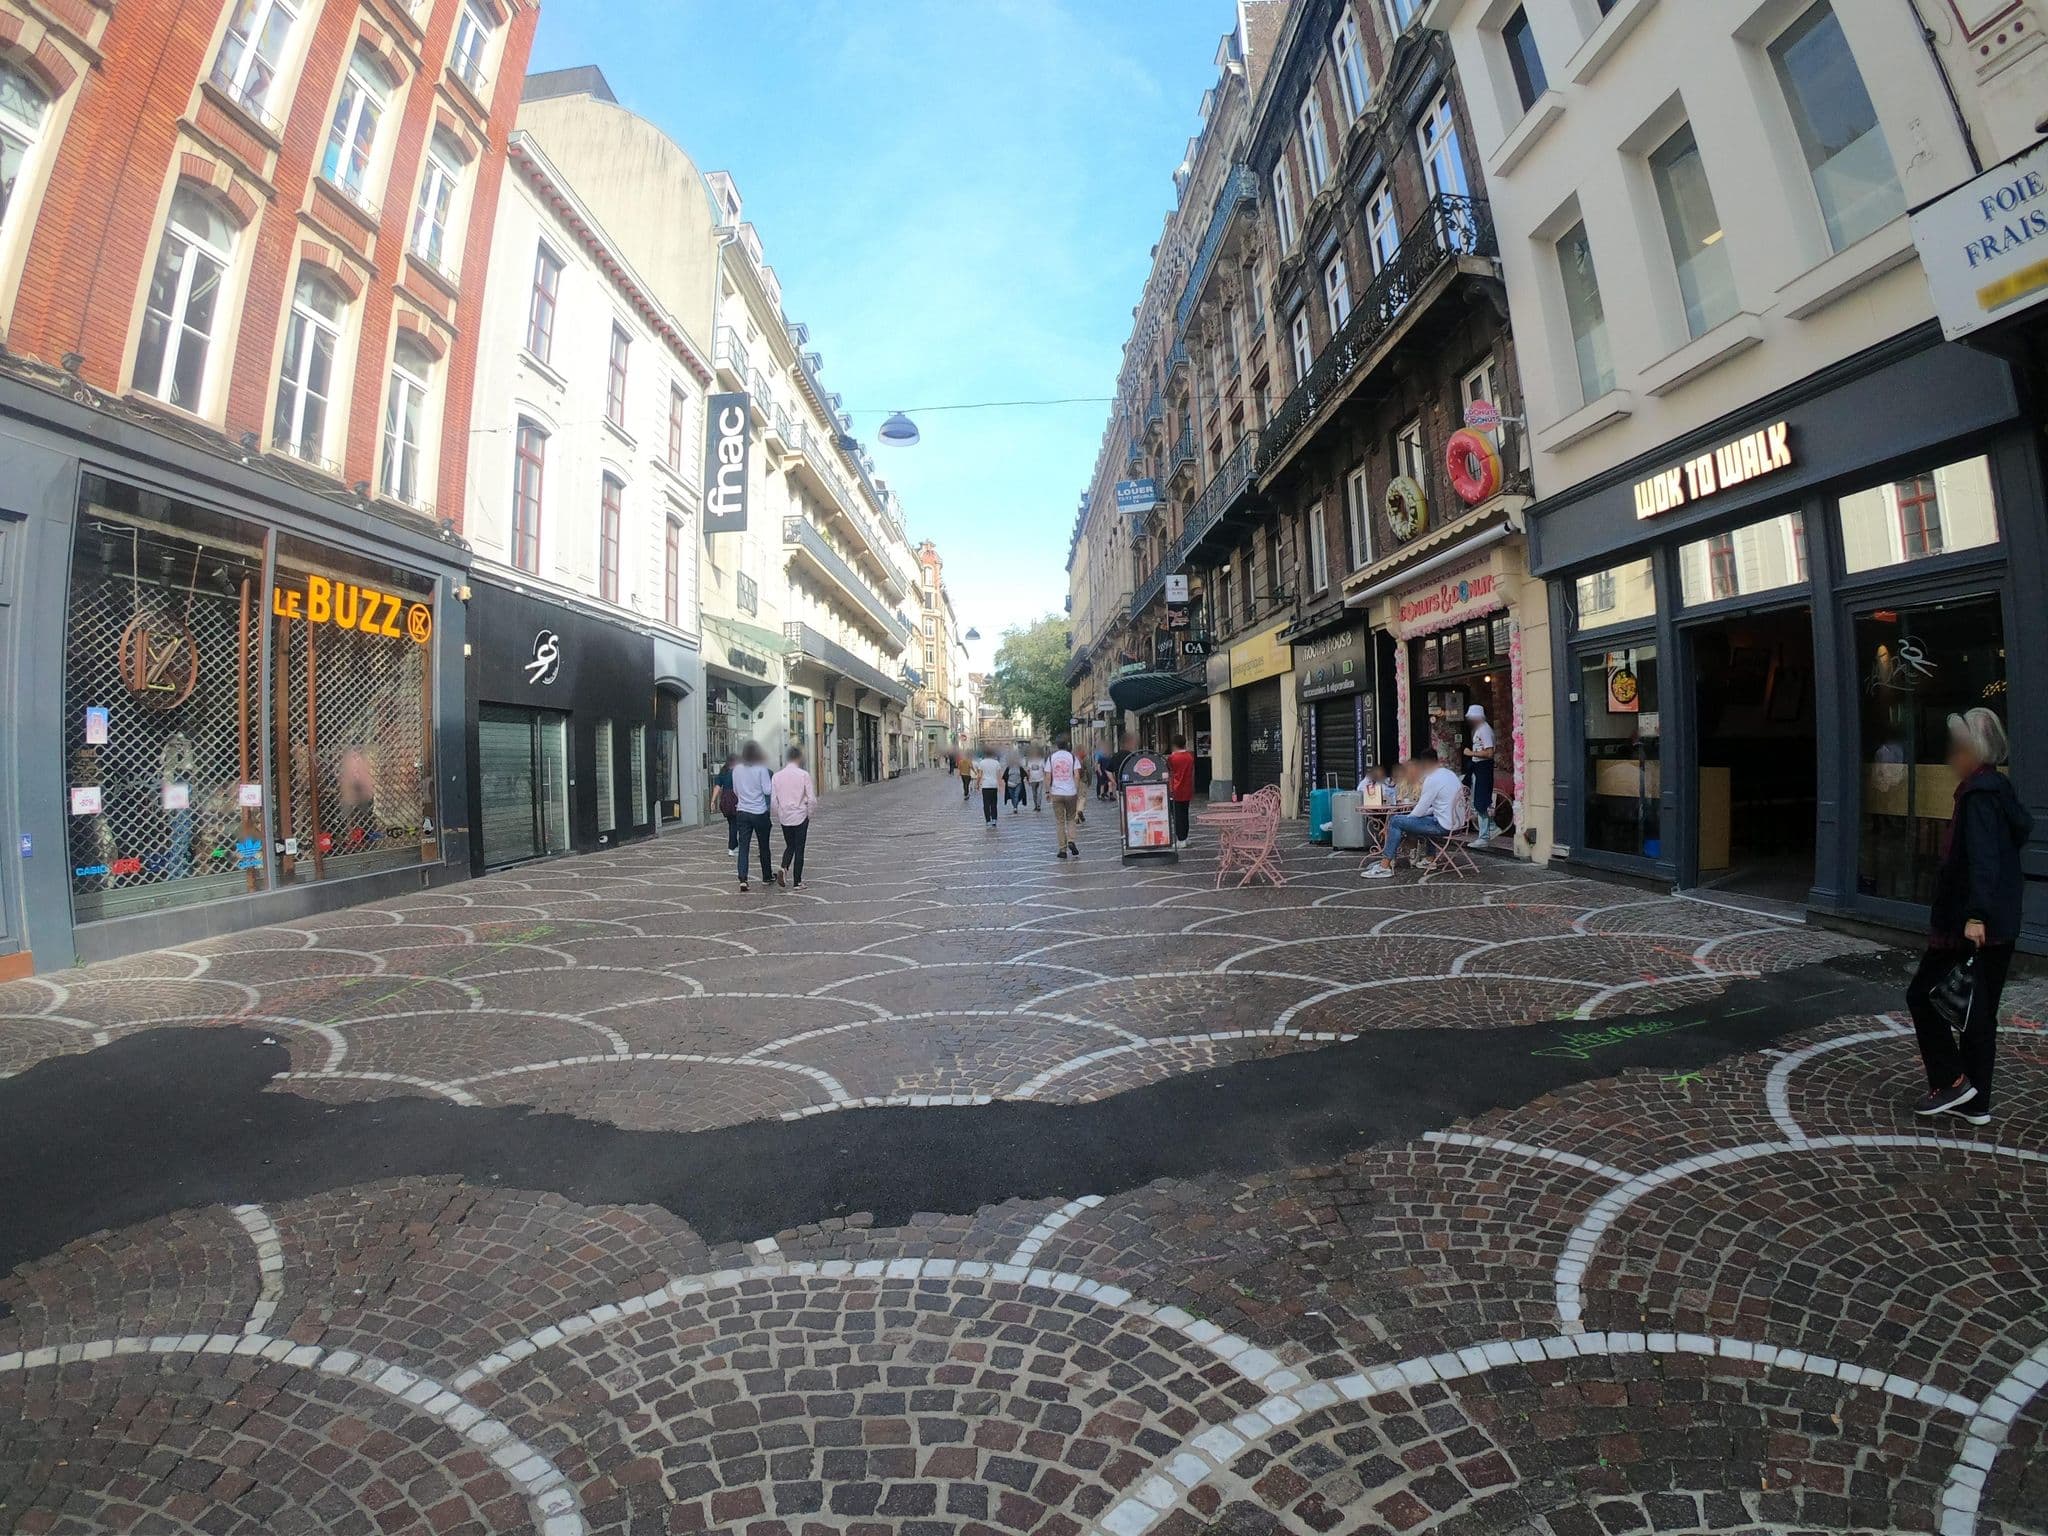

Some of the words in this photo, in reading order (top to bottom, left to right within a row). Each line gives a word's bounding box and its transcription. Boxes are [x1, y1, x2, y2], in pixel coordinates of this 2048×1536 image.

[1979, 171, 2047, 223] FOIE
[1963, 209, 2048, 269] FRAIS
[707, 406, 745, 517] fnac
[1634, 466, 1685, 520] WOK
[1685, 453, 1716, 500] TO
[1716, 421, 1792, 489] WALK
[1117, 486, 1154, 497] LOUER
[273, 587, 301, 619] LE
[307, 575, 402, 638] BUZZ
[1399, 593, 1440, 622] DONUTS
[1441, 584, 1453, 613] &
[1327, 630, 1352, 653] house
[75, 863, 109, 876] CASIO
